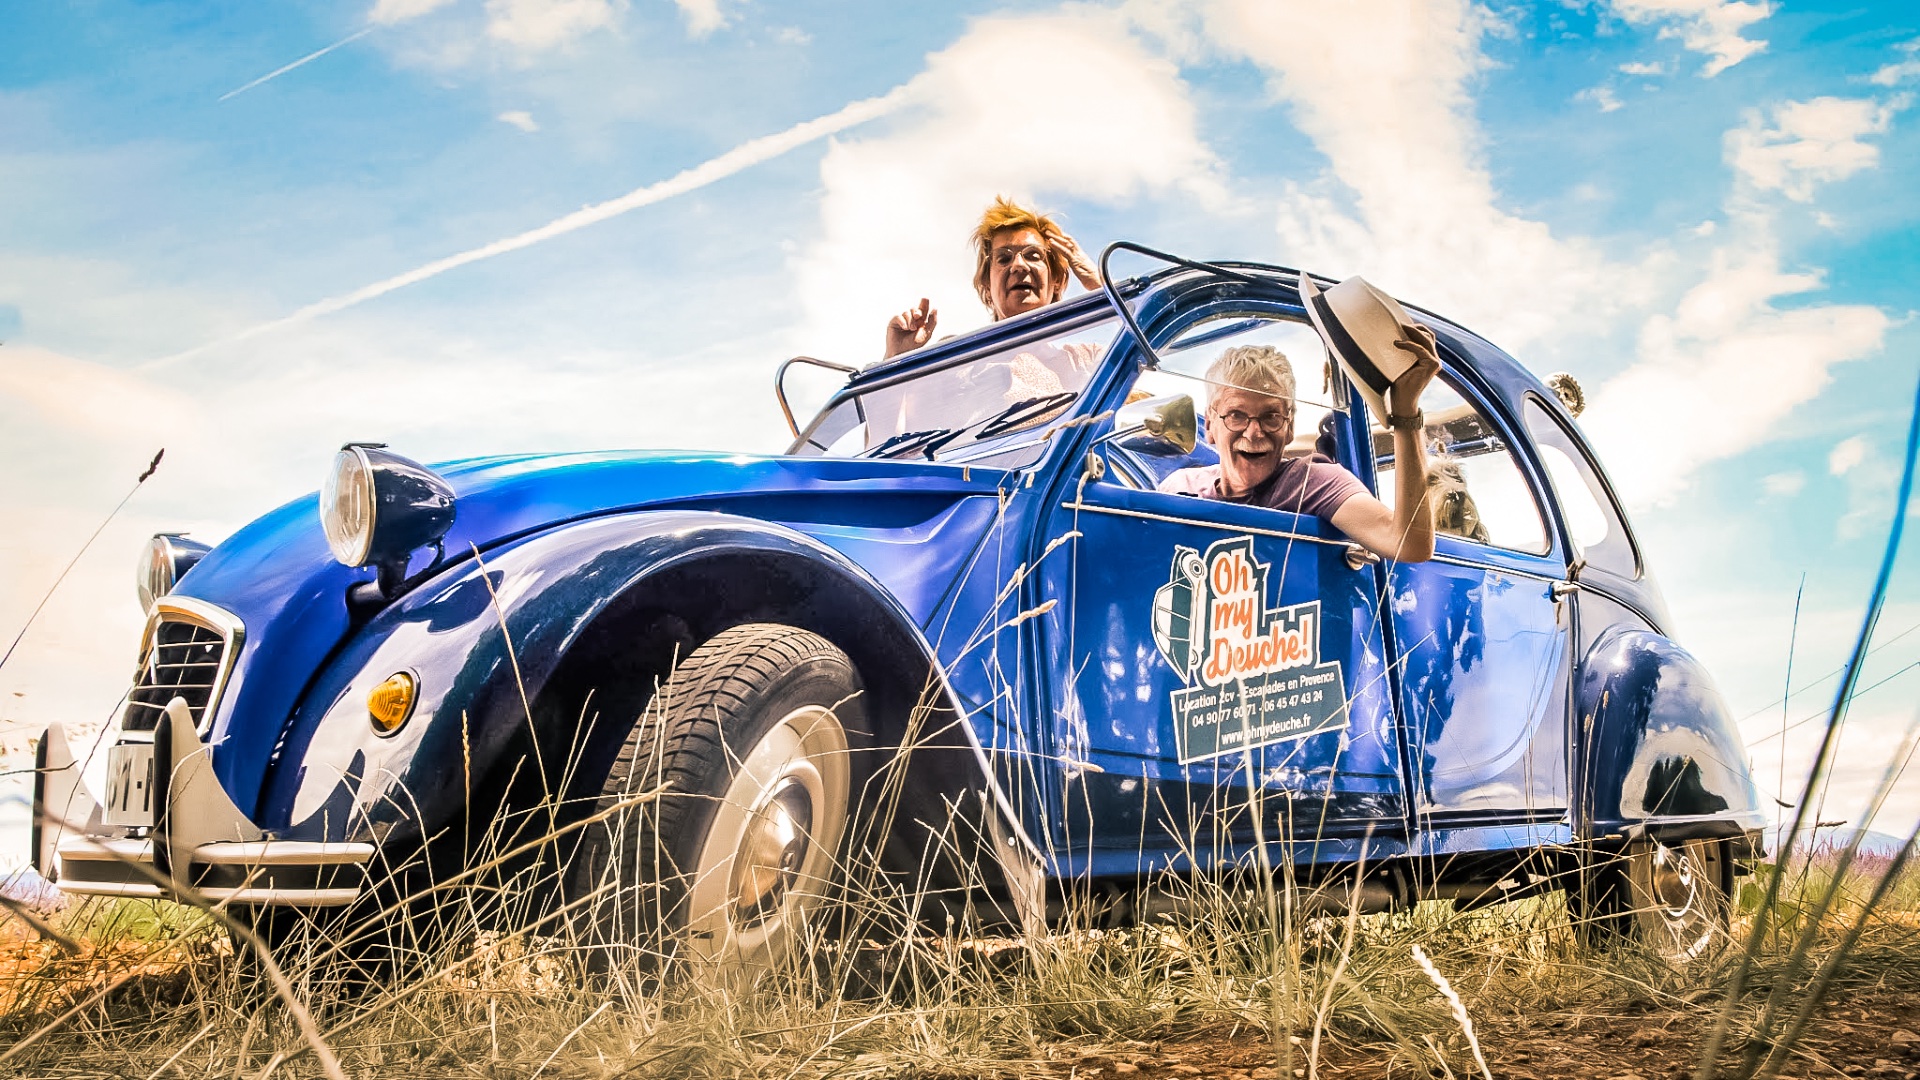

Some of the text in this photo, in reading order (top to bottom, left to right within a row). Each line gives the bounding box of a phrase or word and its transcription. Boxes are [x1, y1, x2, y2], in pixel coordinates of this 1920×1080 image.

[1214, 554, 1249, 595] Oh
[1214, 597, 1253, 640] my
[1206, 620, 1308, 680] Deuche!
[1178, 694, 1217, 712] Location
[1219, 690, 1235, 704] 2cv
[1287, 679, 1298, 690] en
[1300, 672, 1335, 688] Provence
[1192, 713, 1204, 728] 04
[1206, 711, 1218, 725] 90
[1220, 708, 1231, 722] 77
[1233, 706, 1244, 719] 60
[1247, 703, 1257, 716] 71
[1264, 699, 1275, 712] 06
[1276, 697, 1288, 709] 45
[1289, 694, 1299, 707] 47
[1300, 692, 1312, 704] 43
[1313, 689, 1323, 702] 24
